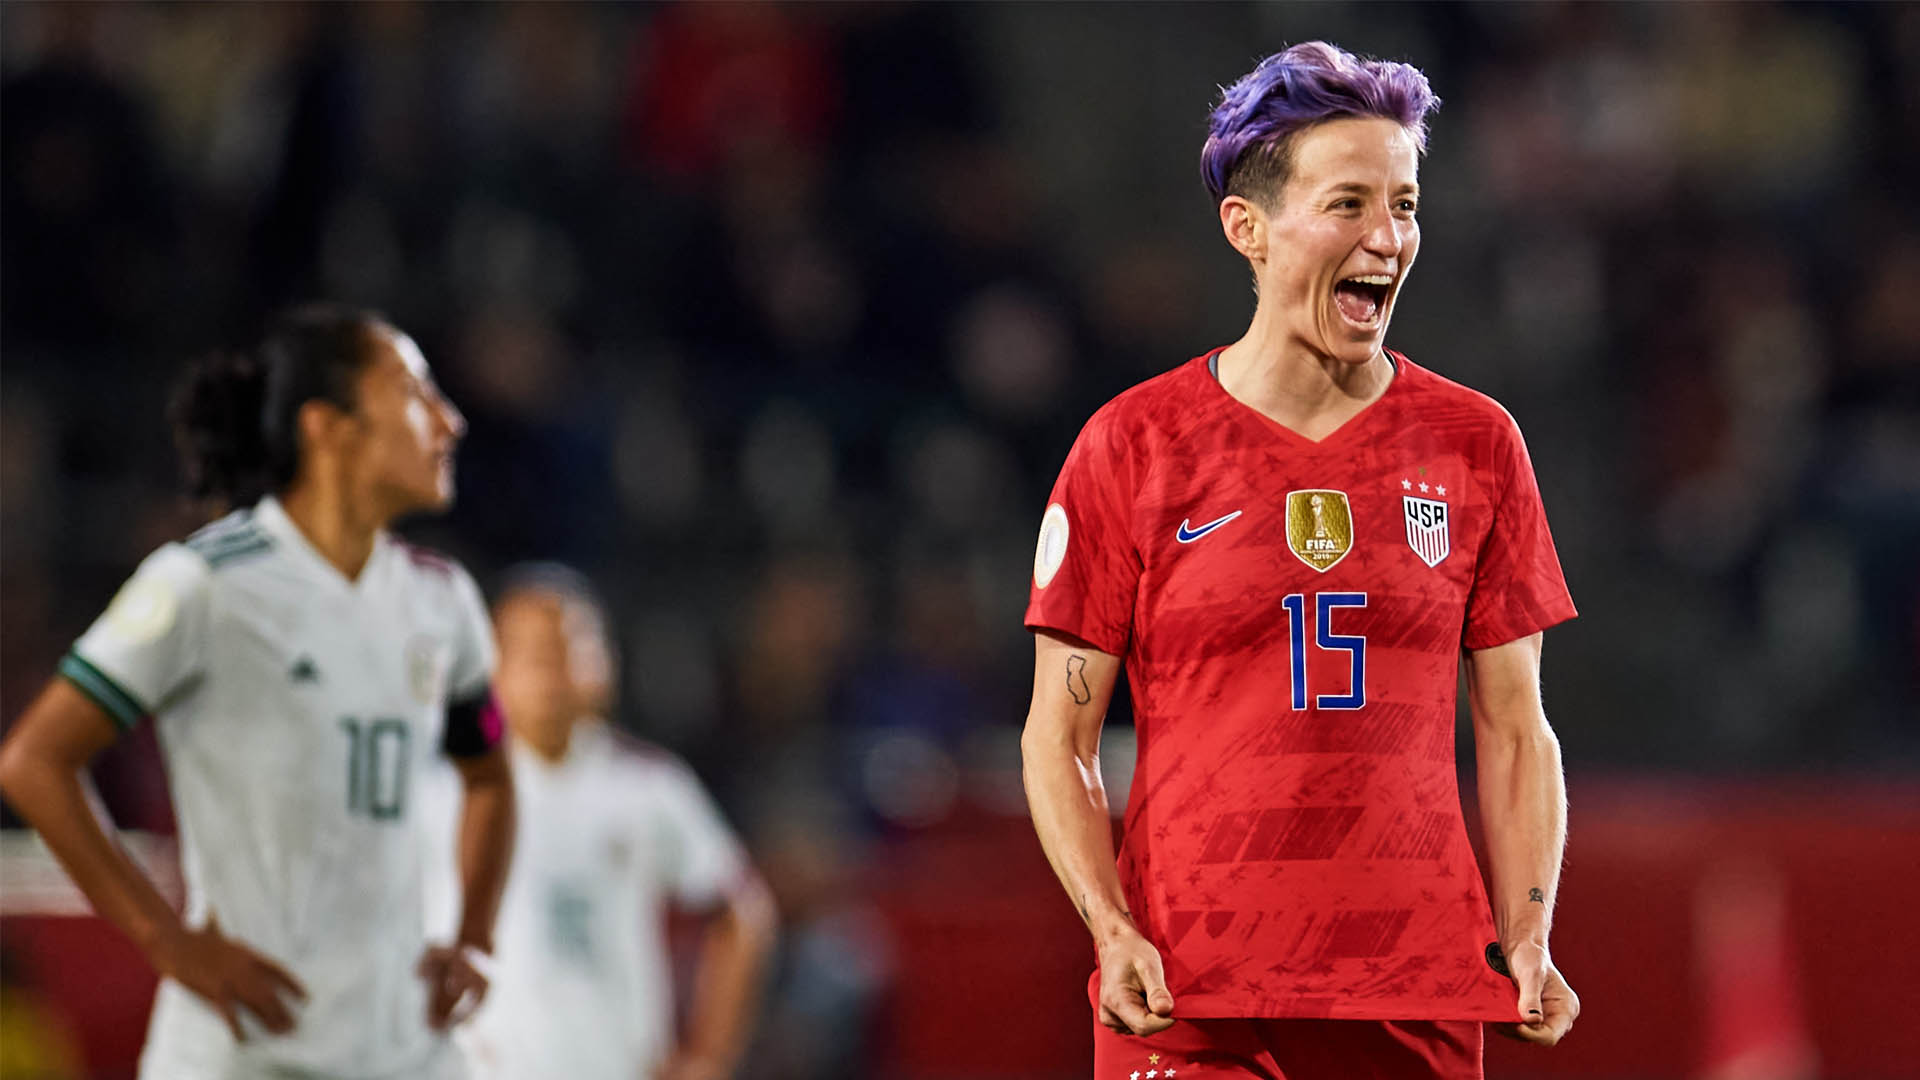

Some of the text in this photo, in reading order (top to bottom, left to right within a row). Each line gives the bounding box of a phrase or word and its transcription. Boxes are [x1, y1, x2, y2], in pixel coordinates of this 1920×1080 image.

[1305, 539, 1336, 550] FIFA
[1407, 500, 1444, 528] USA
[1282, 592, 1367, 711] 15
[338, 716, 409, 820] 10
